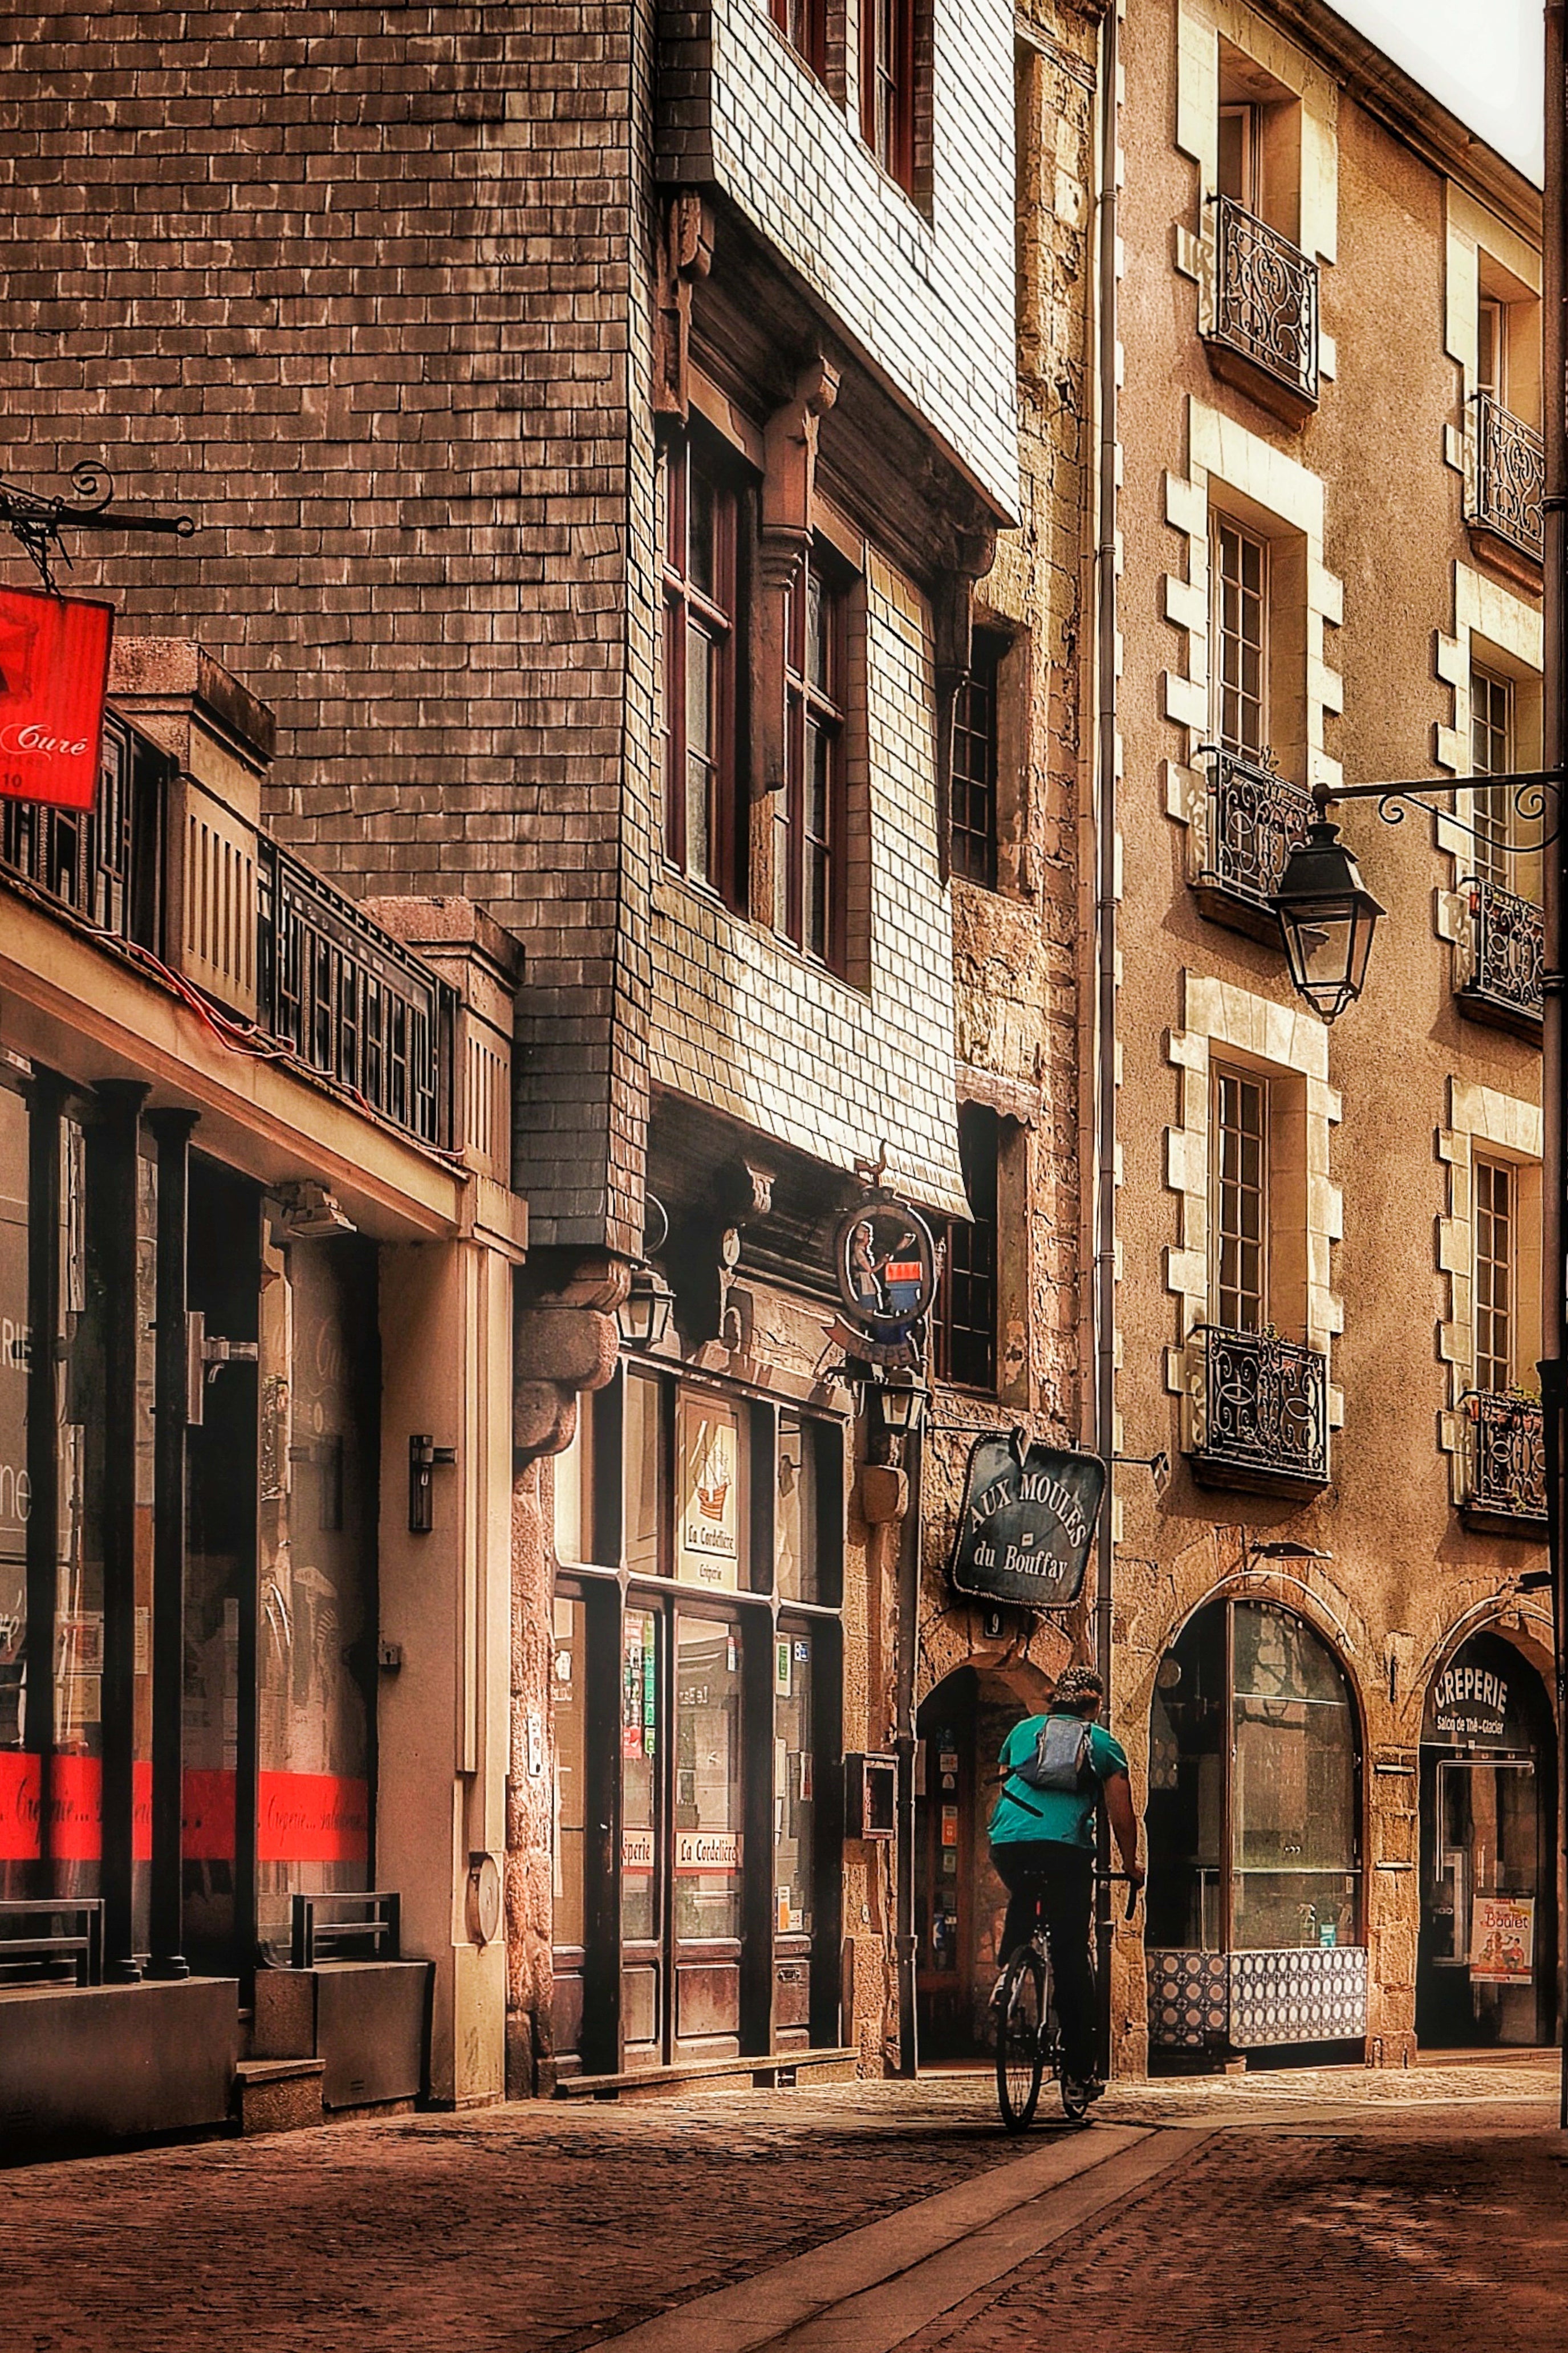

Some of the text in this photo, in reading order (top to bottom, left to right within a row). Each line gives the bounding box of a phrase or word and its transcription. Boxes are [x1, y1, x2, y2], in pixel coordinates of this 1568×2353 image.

[1, 724, 90, 761] Curé
[0, 1316, 33, 1374] RIE
[970, 1473, 1087, 1548] AUX MOULES
[974, 1541, 1068, 1585] du Bouffay
[992, 1613, 1000, 1633] 9
[1434, 1667, 1508, 1714] CREPERIE
[1437, 1715, 1456, 1732] Salon
[1456, 1716, 1465, 1732] de
[681, 1839, 692, 1861] La
[1486, 1912, 1528, 1928] Boulet
